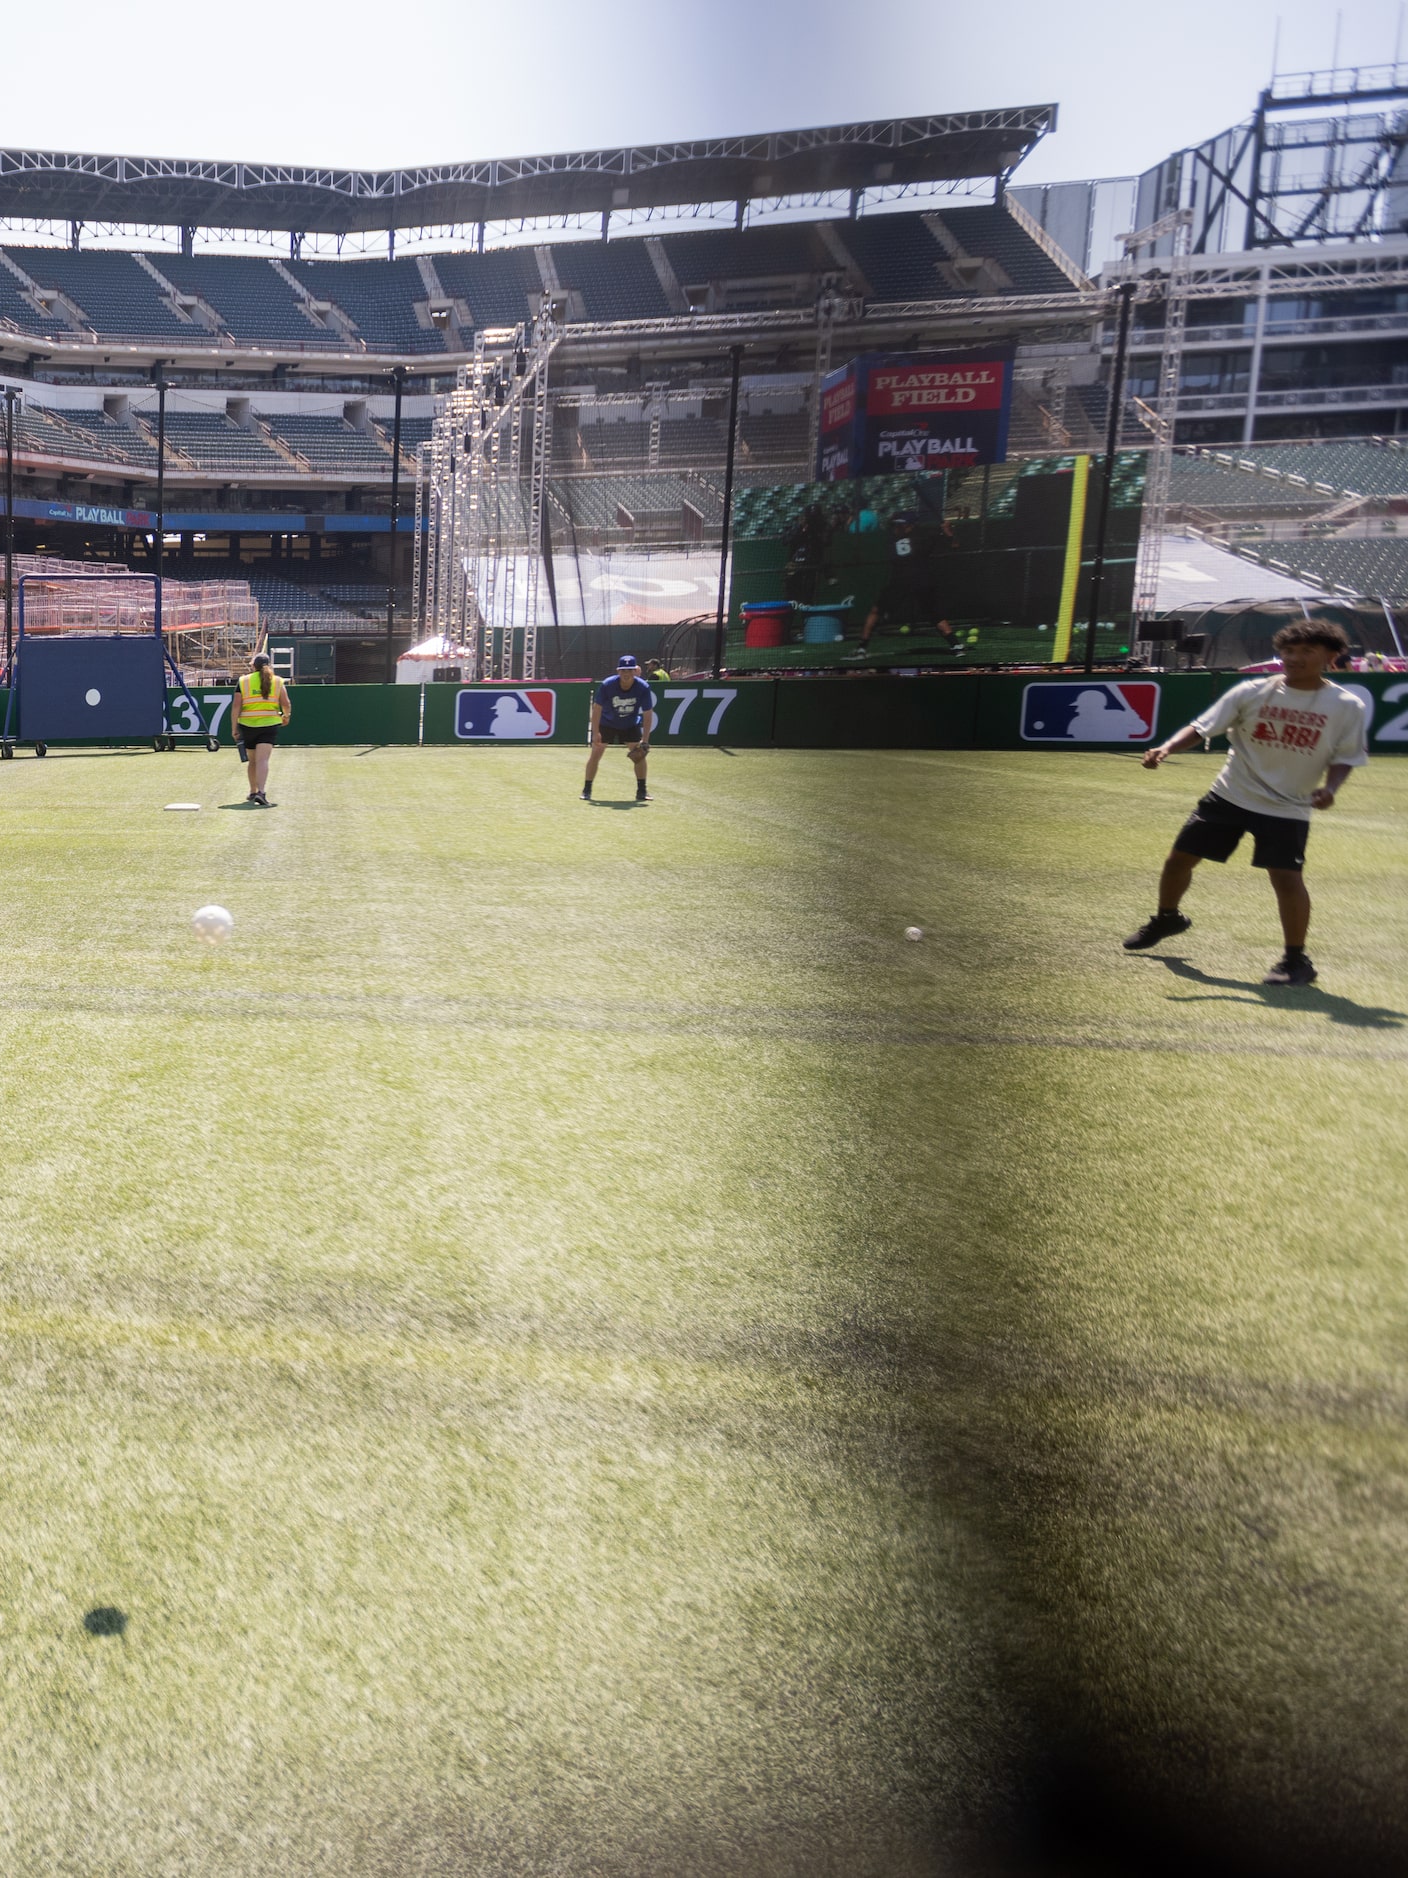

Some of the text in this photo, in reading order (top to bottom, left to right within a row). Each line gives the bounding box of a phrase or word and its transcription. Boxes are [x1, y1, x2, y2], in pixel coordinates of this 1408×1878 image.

[874, 371, 996, 390] PLAYBALL
[891, 387, 977, 407] FIELD
[927, 452, 978, 470] PARK
[163, 694, 232, 737] 37
